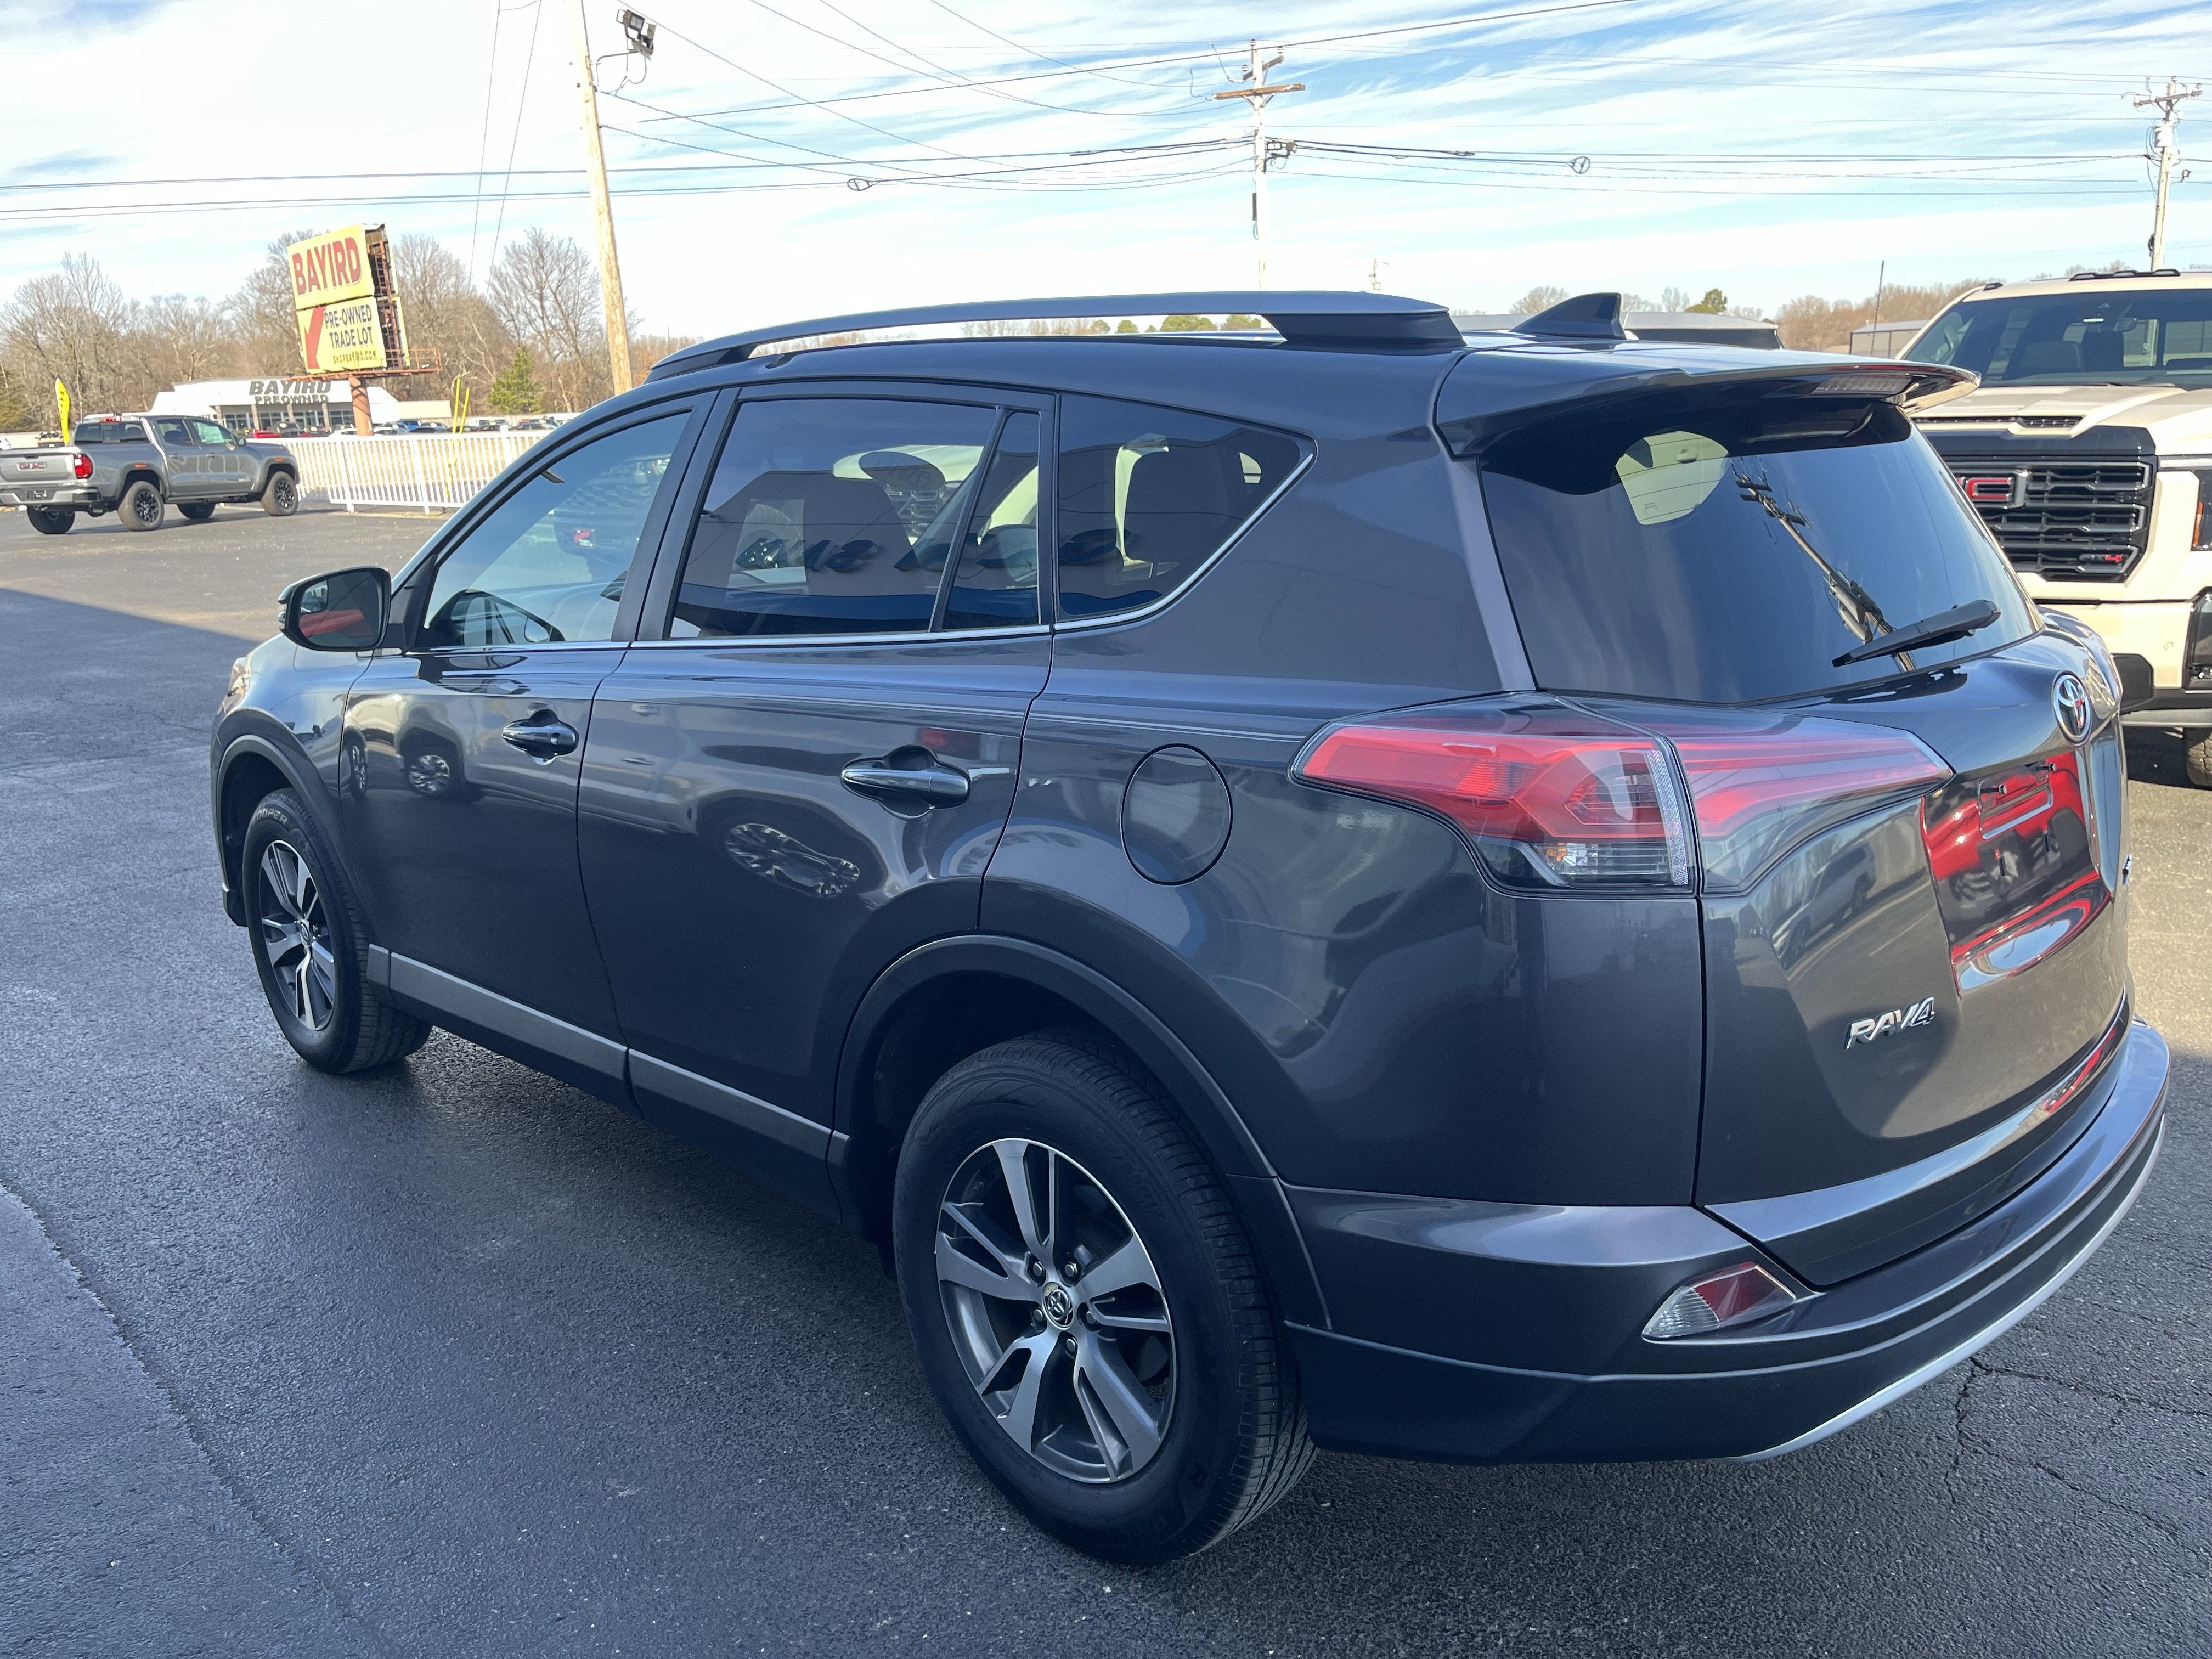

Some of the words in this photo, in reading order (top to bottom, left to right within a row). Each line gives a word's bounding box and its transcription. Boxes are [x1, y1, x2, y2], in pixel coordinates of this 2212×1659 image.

[292, 236, 362, 295] BAYIRD
[324, 304, 372, 329] PRE-OWNED
[329, 329, 356, 349] TRADE
[357, 326, 373, 345] LOT
[249, 380, 331, 395] BAYIRD
[255, 394, 329, 404] PREOWNED
[1844, 995, 1935, 1049] RAV4
